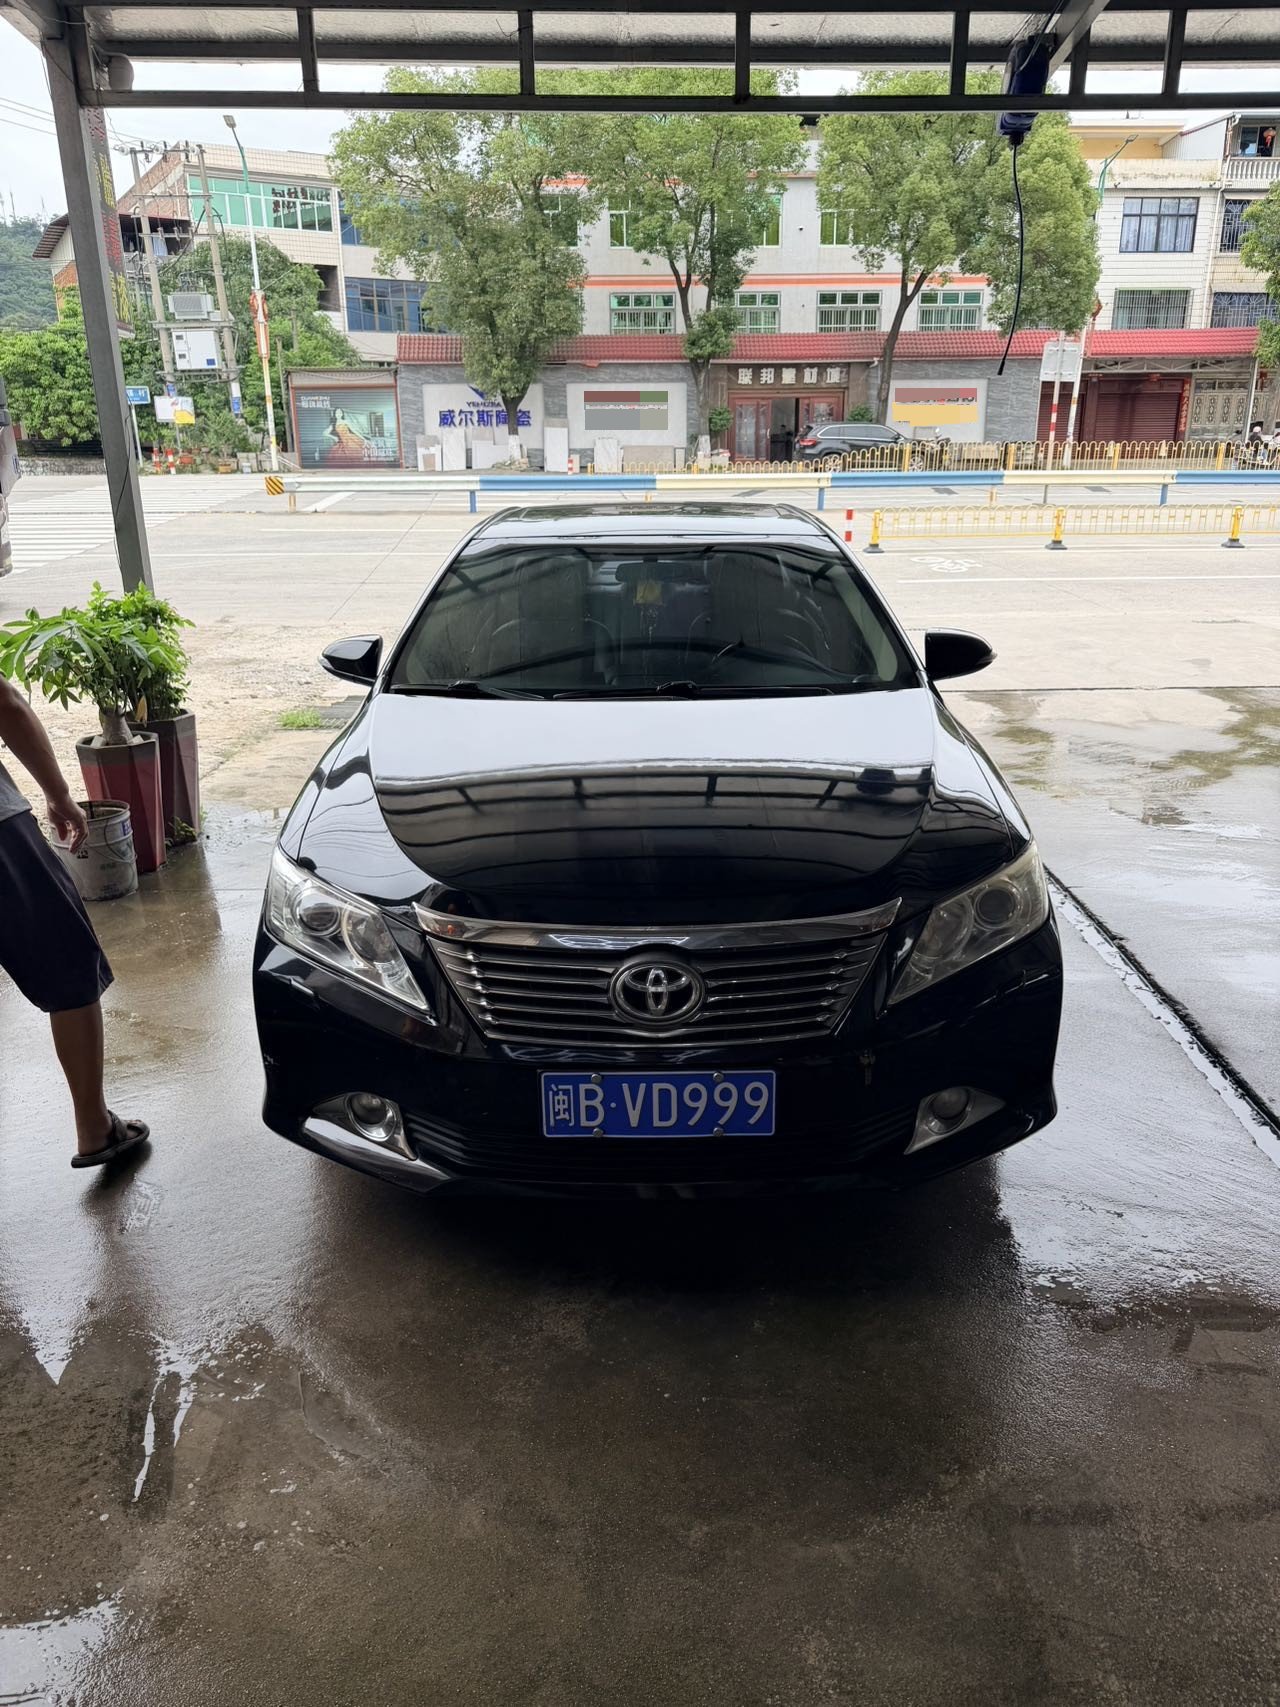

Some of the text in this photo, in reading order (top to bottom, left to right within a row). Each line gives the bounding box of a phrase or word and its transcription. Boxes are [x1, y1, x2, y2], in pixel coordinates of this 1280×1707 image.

[738, 367, 841, 385] 联邦建材城
[439, 409, 531, 428] 威尔斯陶瓷
[549, 1081, 769, 1128] 闽B·VD999
